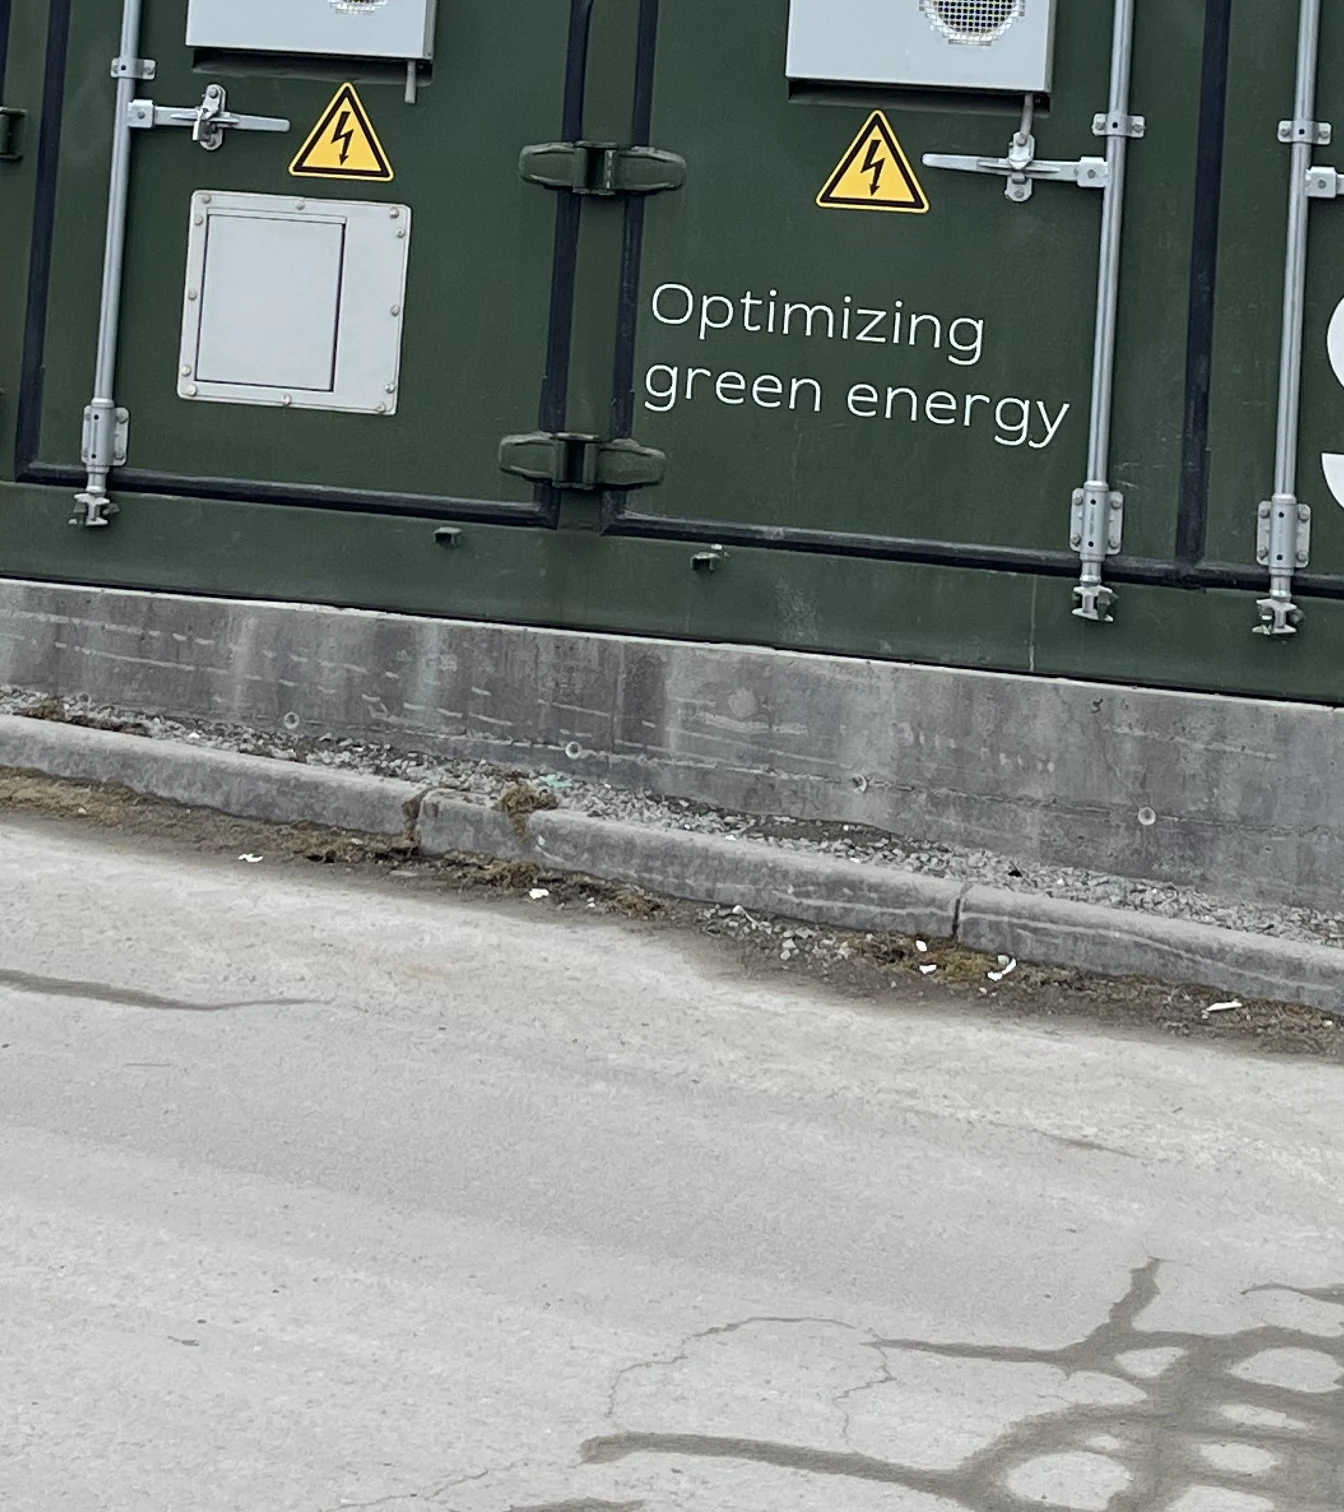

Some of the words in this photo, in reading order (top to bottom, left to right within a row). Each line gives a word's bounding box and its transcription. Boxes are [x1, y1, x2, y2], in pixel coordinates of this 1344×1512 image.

[652, 283, 984, 365] Optimizing
[644, 363, 821, 412] green
[847, 382, 1069, 448] energy
